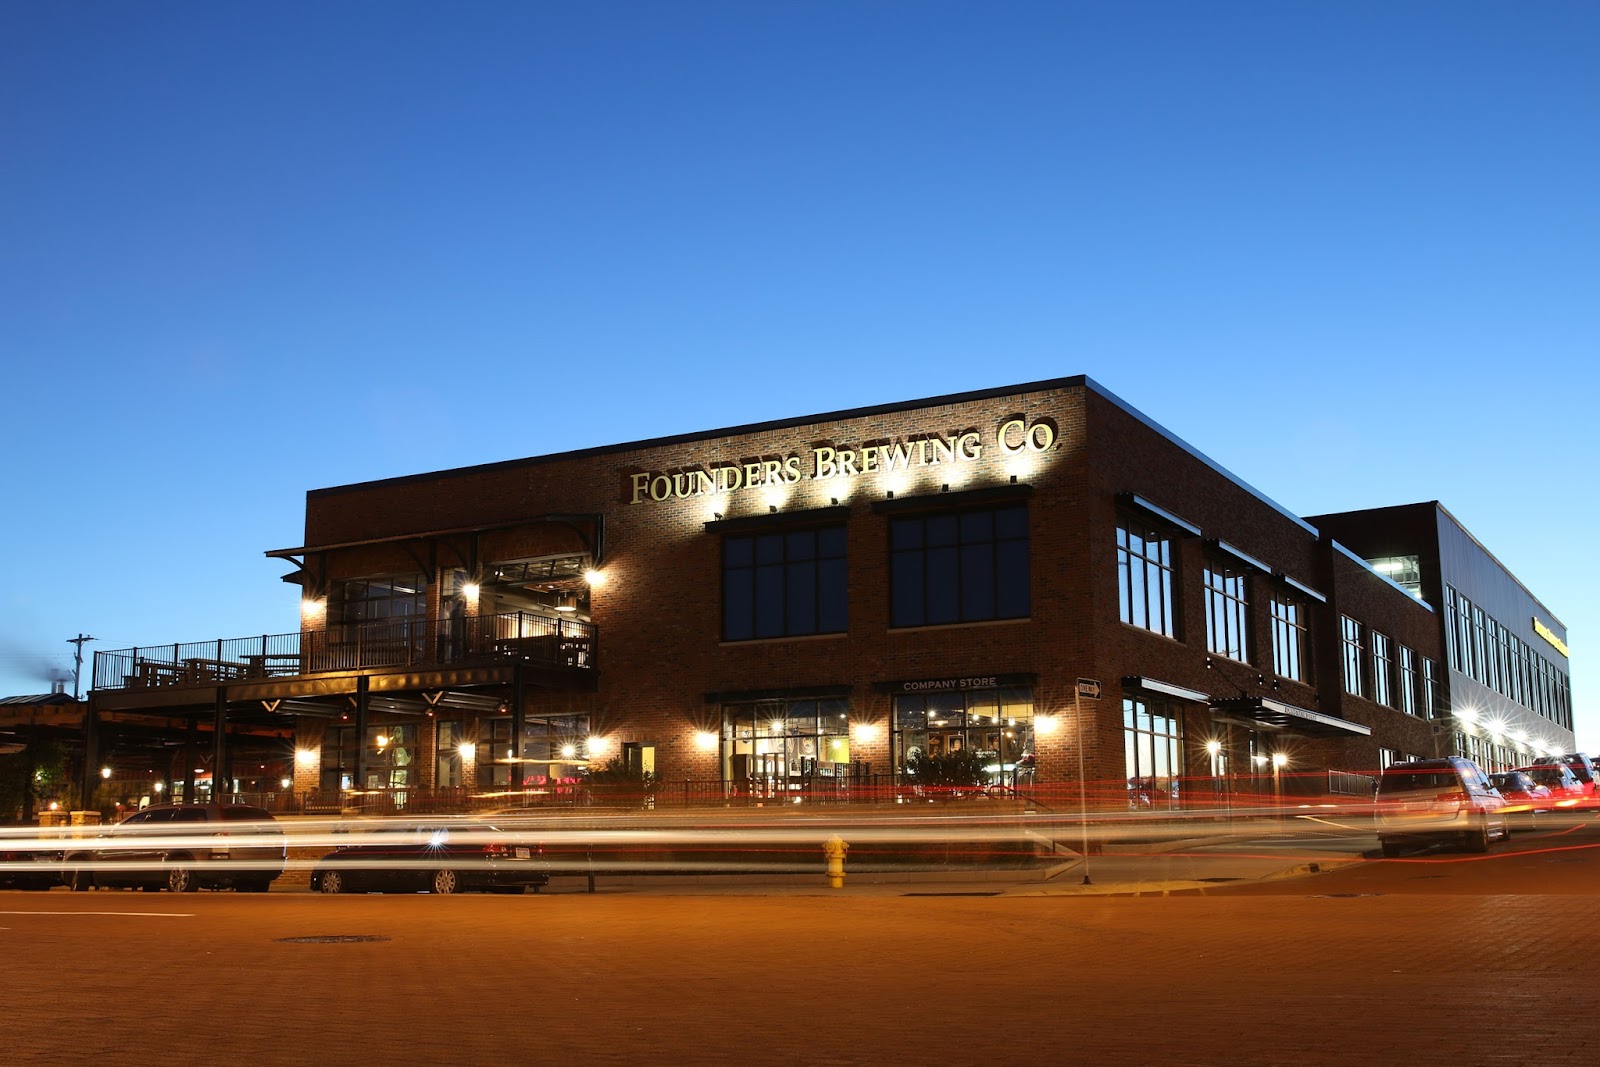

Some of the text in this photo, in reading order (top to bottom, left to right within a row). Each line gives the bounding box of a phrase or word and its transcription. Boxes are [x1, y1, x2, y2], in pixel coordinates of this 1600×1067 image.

[630, 456, 802, 504] FOUNDERS
[813, 432, 983, 480] BREWING
[903, 677, 997, 691] COMPANY STORE
